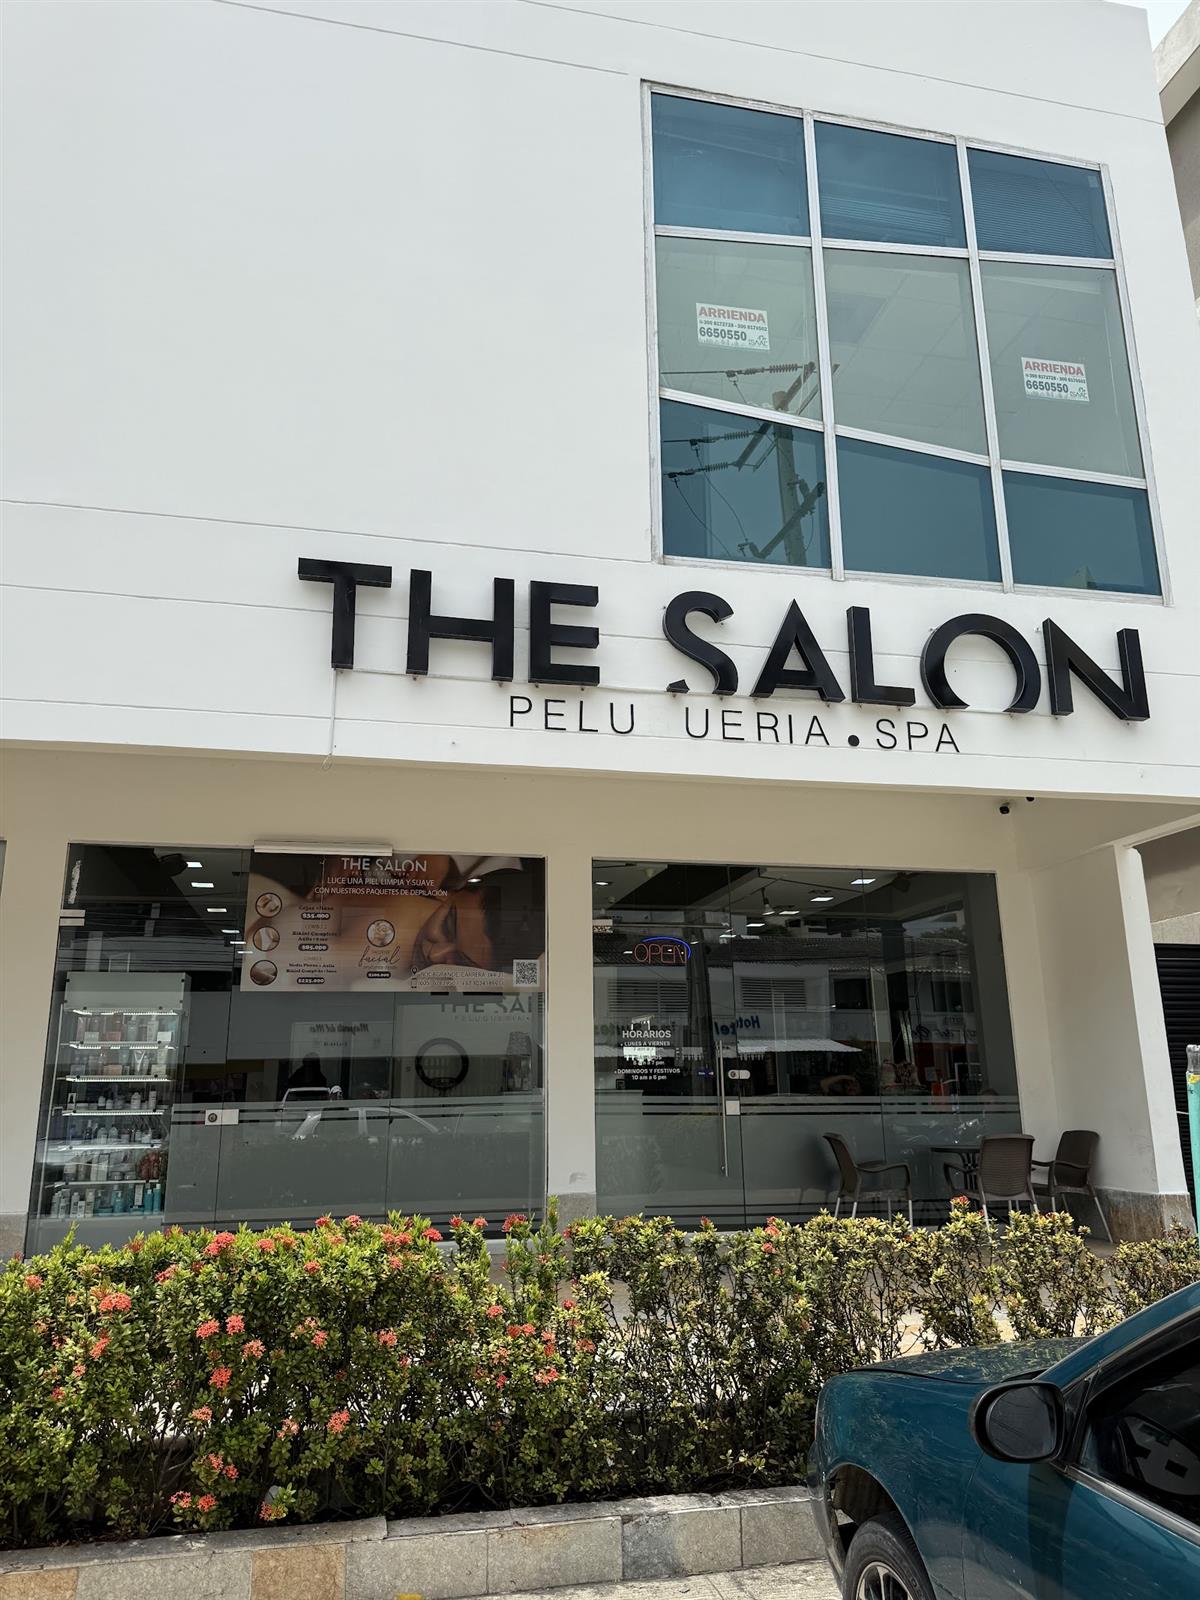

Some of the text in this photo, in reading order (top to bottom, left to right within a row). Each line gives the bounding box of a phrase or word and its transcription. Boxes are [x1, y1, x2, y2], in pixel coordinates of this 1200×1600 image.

[698, 306, 766, 324] ARRIENDA
[699, 326, 747, 341] 6650550
[1024, 361, 1084, 377] ARRIENDA
[1025, 380, 1069, 394] 6650550
[297, 557, 1151, 722] THE SALON
[876, 717, 961, 754] SPA
[341, 857, 427, 873] THE SALON
[327, 876, 346, 885] LUCE
[347, 877, 364, 885] UNA
[365, 877, 379, 885] PIEL
[380, 878, 405, 886] LIMPIA
[412, 879, 435, 887] SUAVE
[314, 886, 448, 897] CON NUESTROS PAQUETES DE DEPILACIÓN
[632, 943, 687, 964] OPEN
[622, 1030, 672, 1039] HORARIOS
